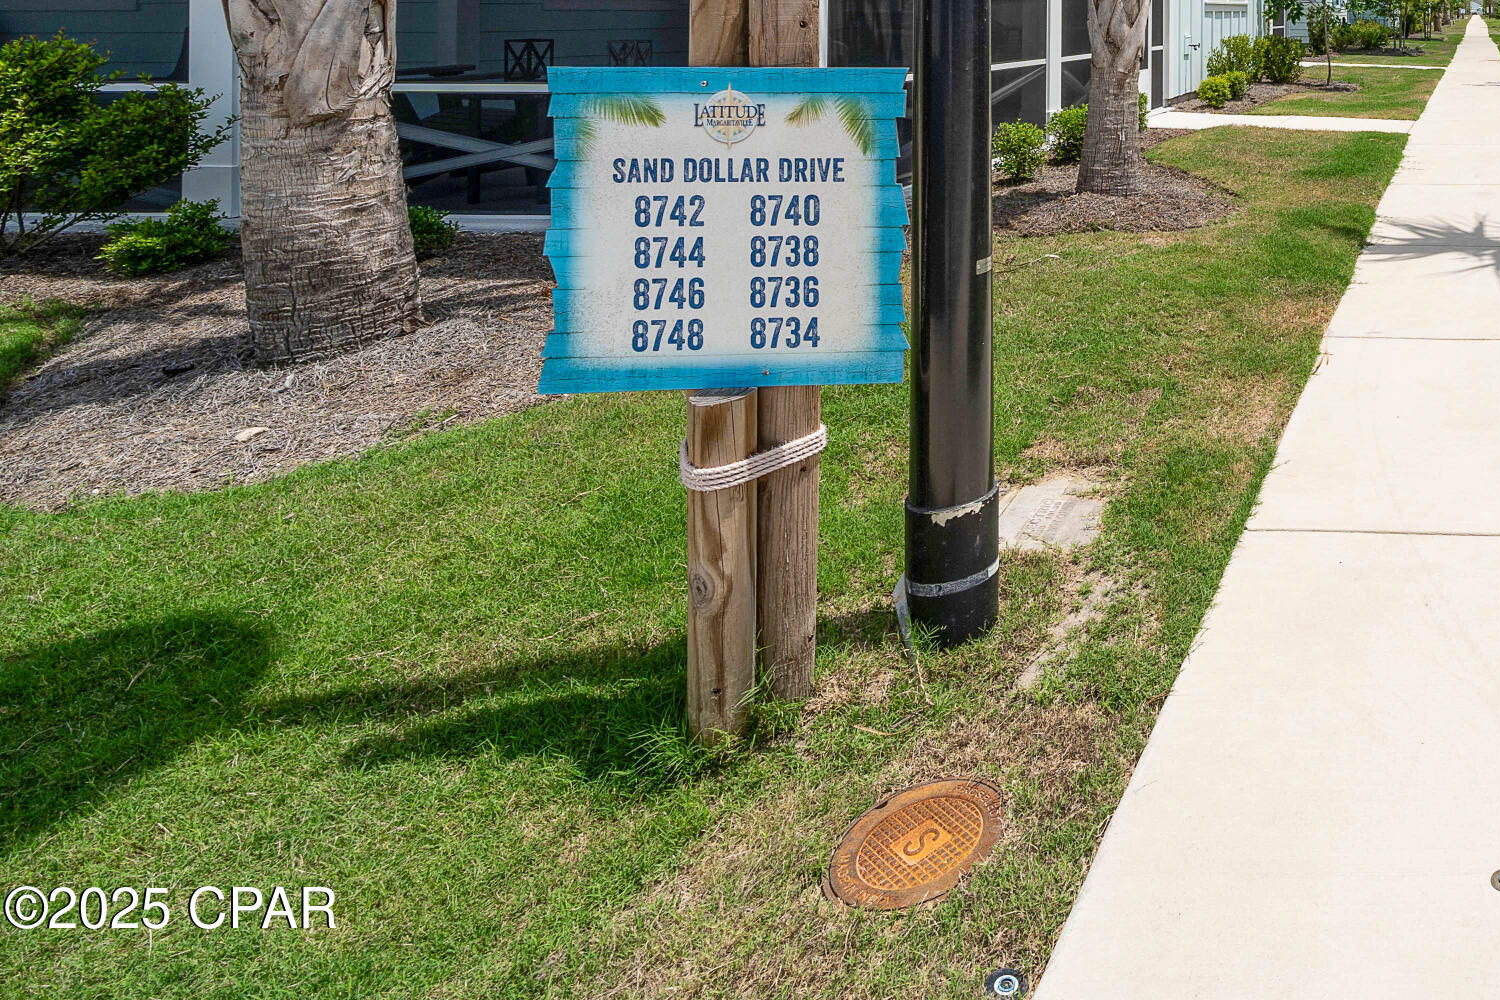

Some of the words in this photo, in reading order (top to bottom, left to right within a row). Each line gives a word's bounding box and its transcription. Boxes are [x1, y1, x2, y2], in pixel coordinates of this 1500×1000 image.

[694, 103, 766, 127] LATITUDE
[613, 158, 674, 183] SAND
[684, 158, 769, 182] DOLLAR
[779, 158, 844, 182] DRIVE
[635, 195, 705, 227] 8742
[751, 195, 820, 226] 8740
[635, 237, 705, 269] 8744
[751, 235, 819, 267] 8738
[634, 277, 704, 310] 8746
[750, 276, 819, 308] 8736
[632, 319, 703, 352] 8748
[751, 317, 820, 349] 8734
[903, 827, 940, 857] S
